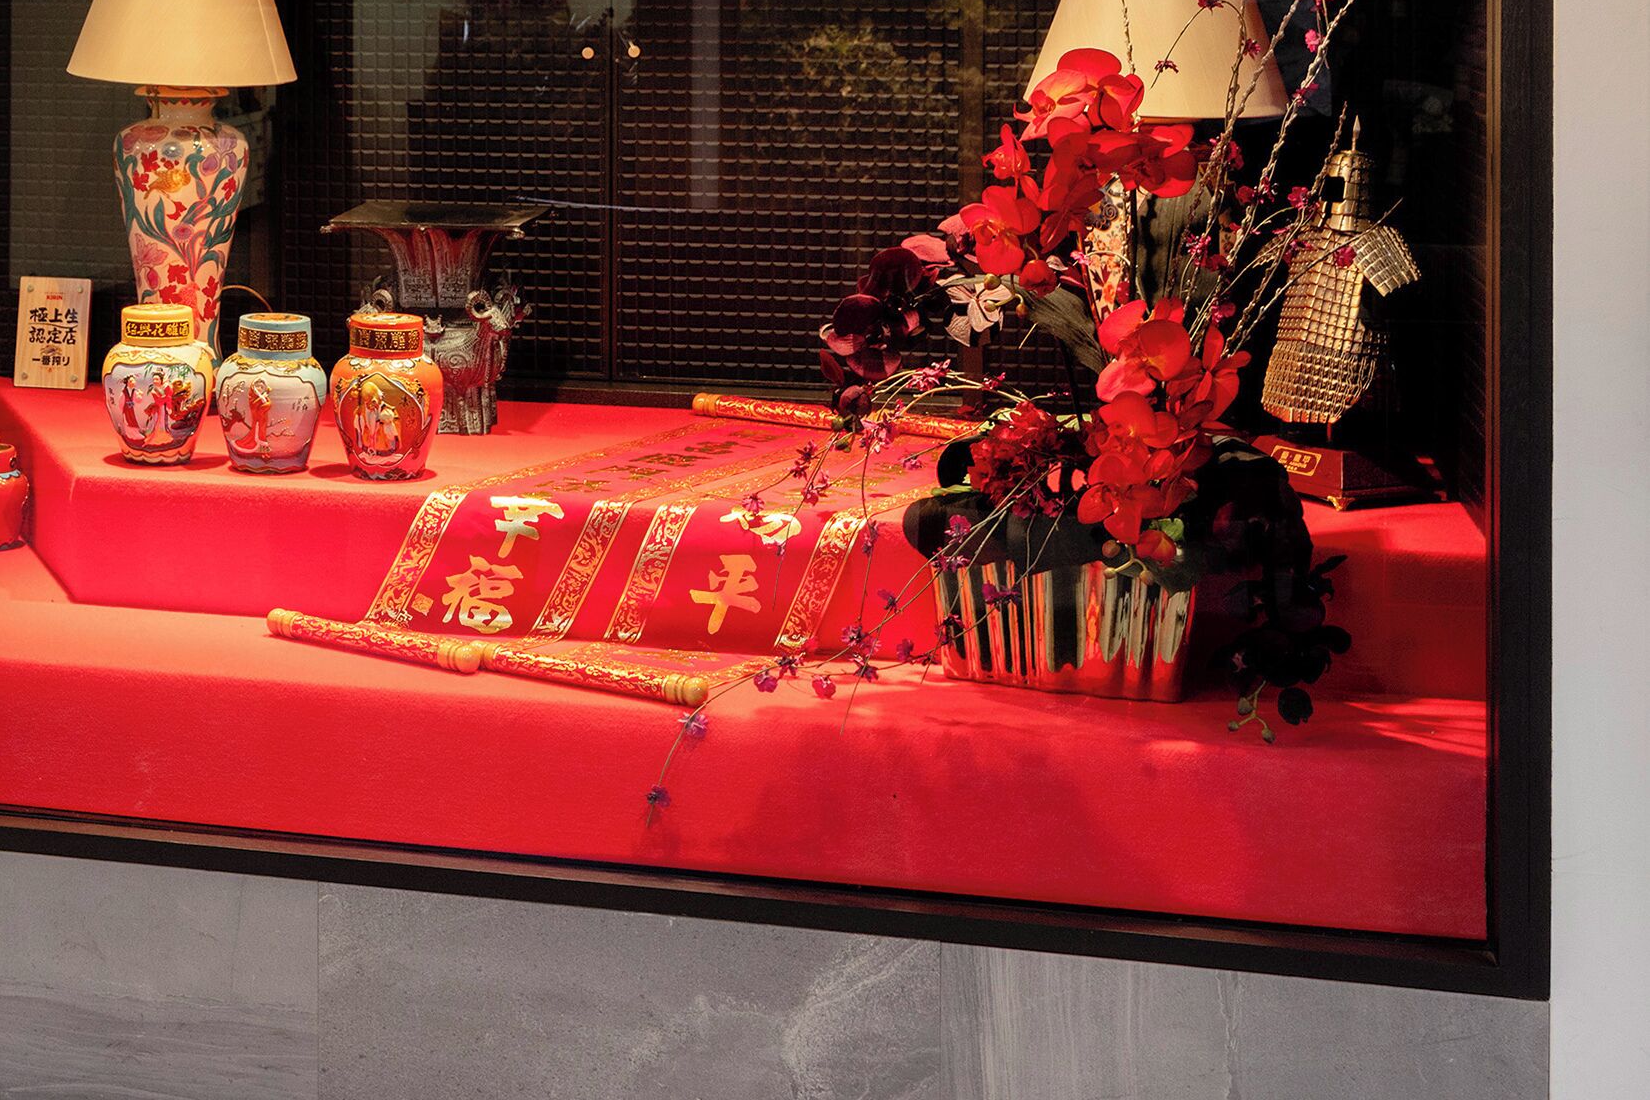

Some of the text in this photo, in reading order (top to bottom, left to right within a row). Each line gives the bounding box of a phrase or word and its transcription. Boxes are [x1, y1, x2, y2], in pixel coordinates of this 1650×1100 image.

[30, 307, 79, 323] 極上生
[29, 326, 77, 345] 認定店
[32, 356, 70, 366] 一番搾り
